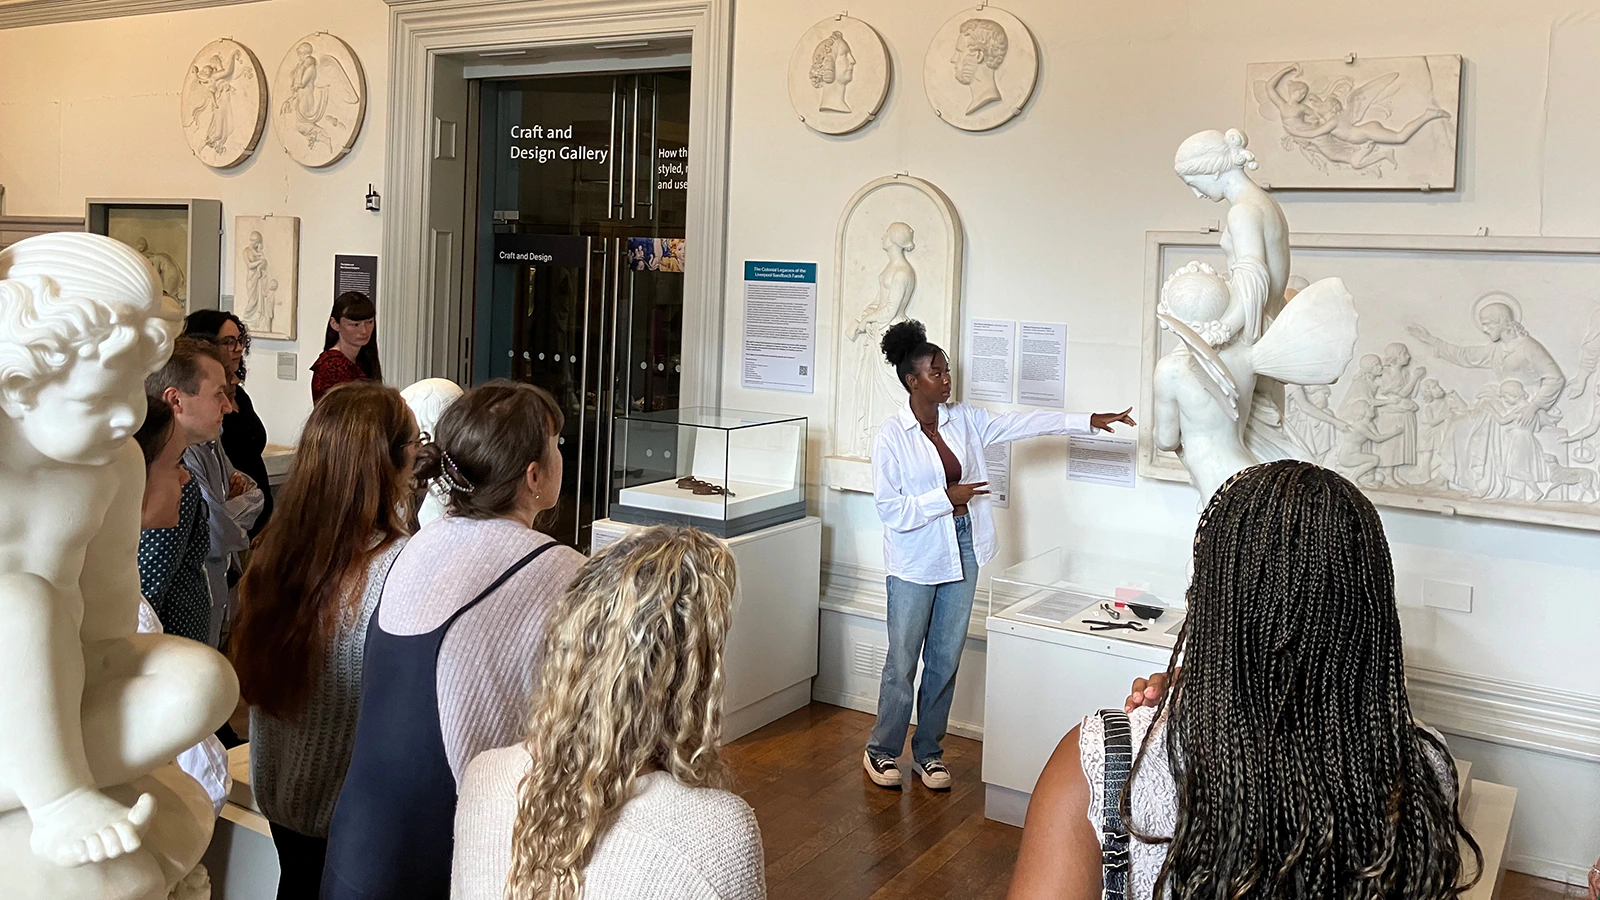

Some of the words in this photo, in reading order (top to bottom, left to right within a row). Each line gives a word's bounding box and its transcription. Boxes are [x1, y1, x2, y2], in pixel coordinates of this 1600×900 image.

[510, 124, 544, 139] Craft
[547, 125, 572, 139] and
[510, 146, 556, 164] Design
[560, 146, 608, 164] Gallery
[658, 148, 678, 158] How
[658, 162, 684, 176] styled,
[658, 178, 673, 190] and
[499, 251, 515, 260] Craft
[530, 252, 552, 262] Design
